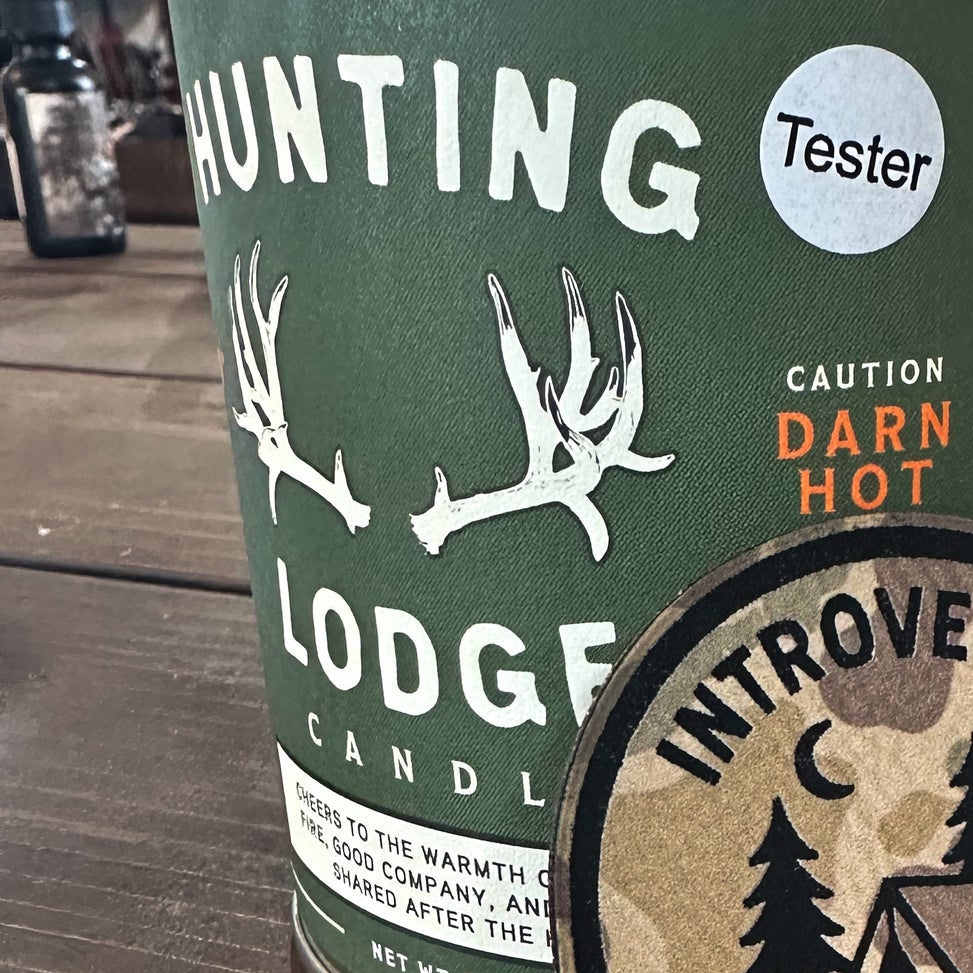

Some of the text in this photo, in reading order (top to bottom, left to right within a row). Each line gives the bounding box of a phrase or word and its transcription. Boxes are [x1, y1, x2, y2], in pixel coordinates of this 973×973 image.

[186, 55, 701, 240] HUNTING
[776, 111, 933, 191] Tester
[786, 356, 945, 391] CAUTION
[776, 400, 951, 460] DARN
[799, 459, 933, 515] HOT
[307, 712, 546, 808] CANDL
[295, 781, 342, 829] CHEERS
[346, 816, 369, 842] TO
[375, 829, 414, 860] THE
[421, 845, 525, 885] WARMTH
[333, 836, 374, 872] GOOD
[382, 861, 495, 912] COMPANY,
[333, 862, 397, 908] SHARED
[406, 897, 475, 934] AFTER
[484, 919, 534, 945] THE
[371, 940, 408, 972] NET
